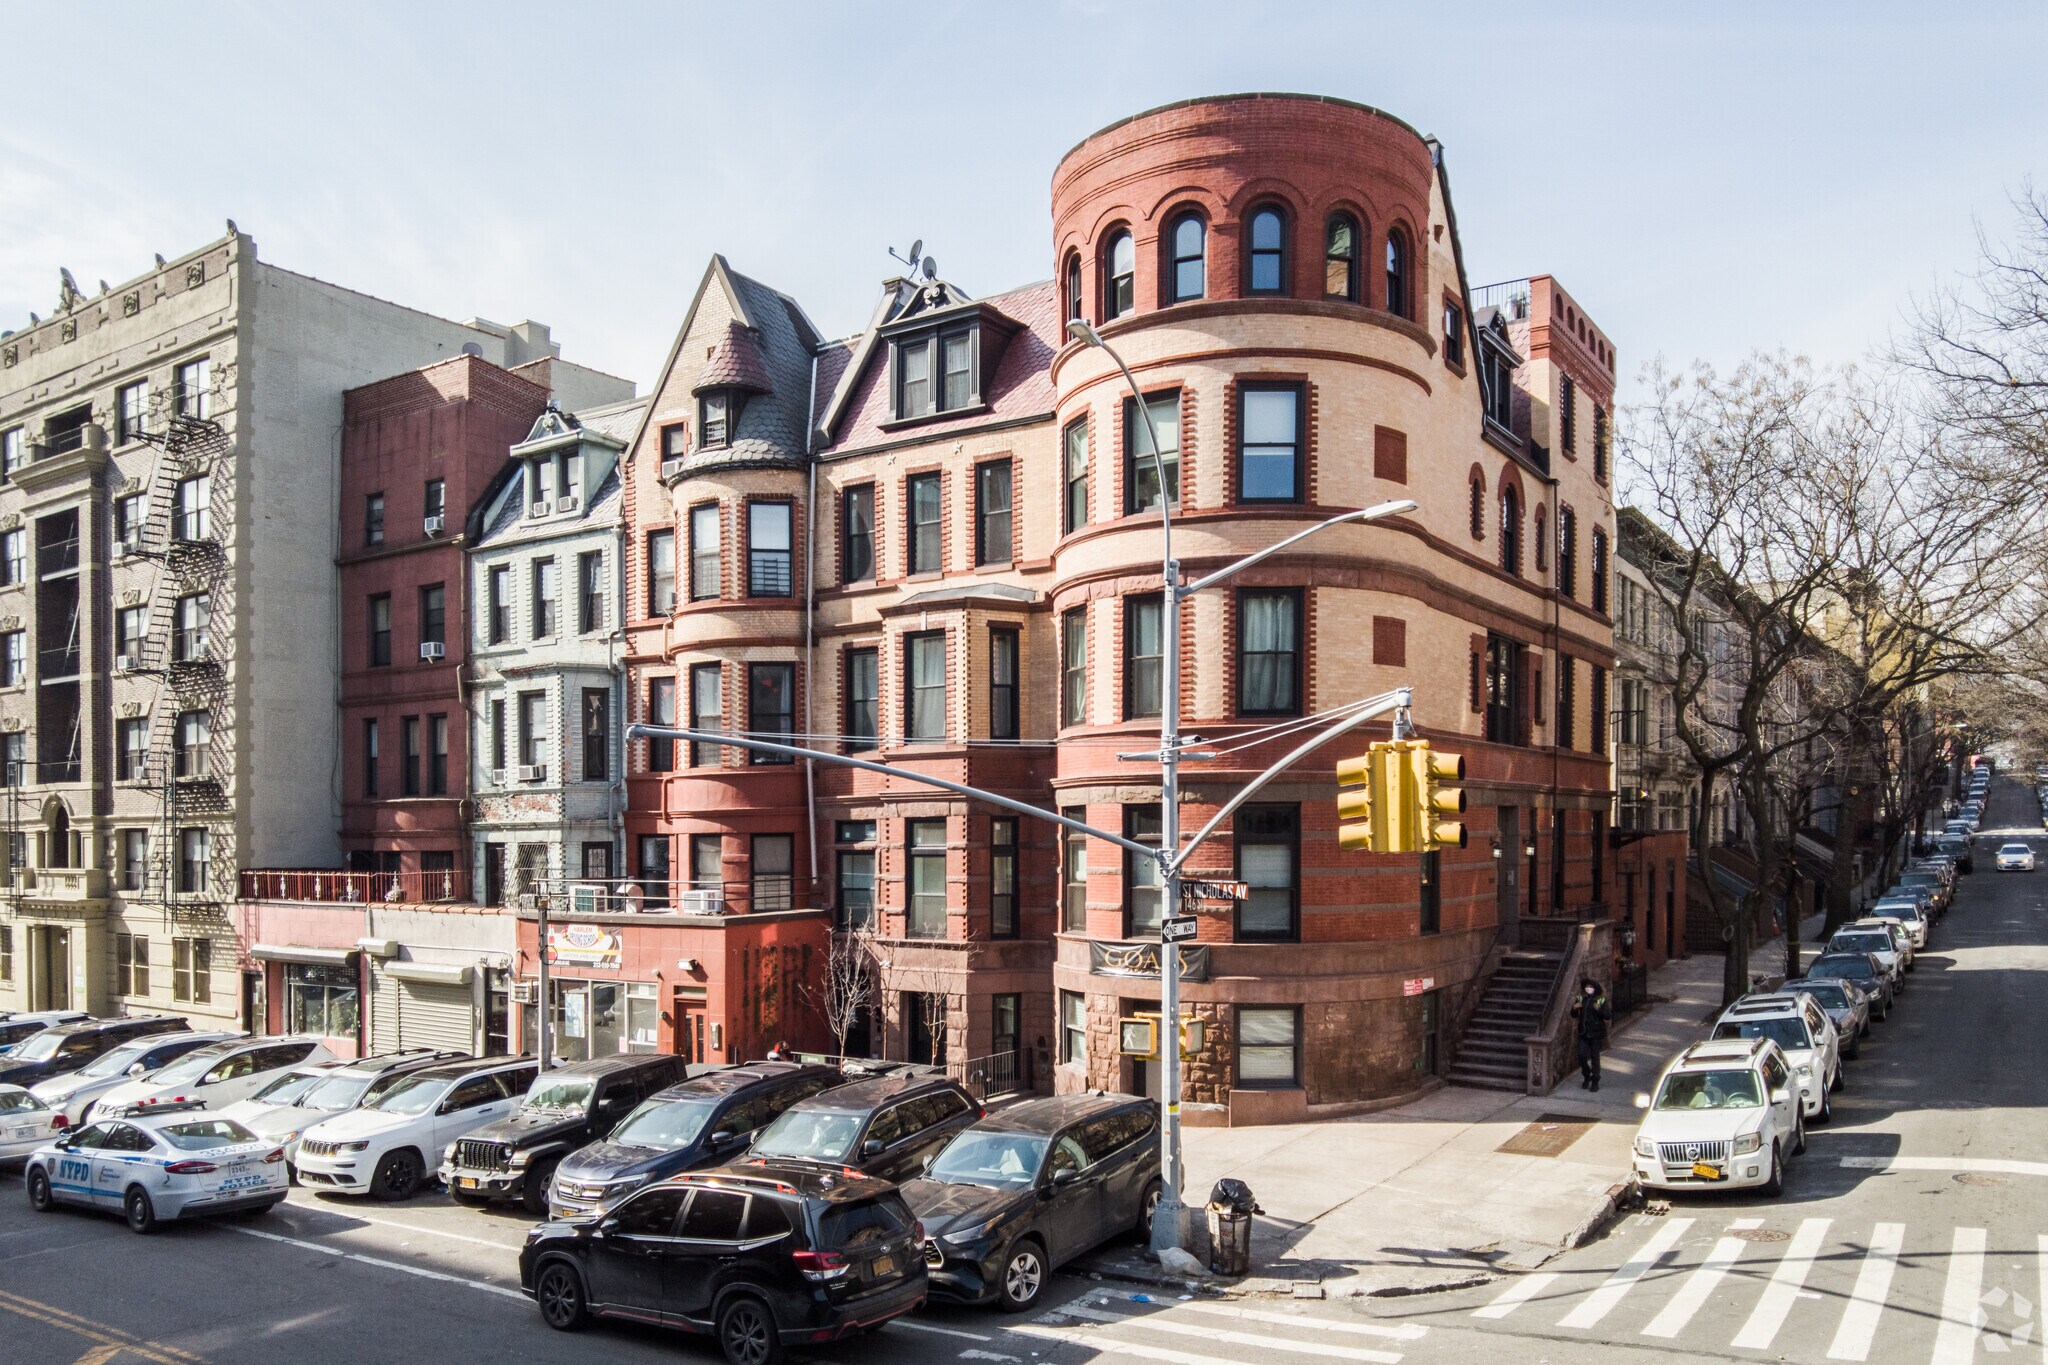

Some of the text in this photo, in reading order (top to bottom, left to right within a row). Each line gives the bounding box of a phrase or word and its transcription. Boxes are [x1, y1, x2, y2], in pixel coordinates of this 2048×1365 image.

[1182, 883, 1247, 899] ST NICHOLAS AV
[1185, 898, 1197, 911] 146
[1165, 923, 1195, 936] ONE WAY
[1105, 949, 1188, 977] GOAS
[59, 1159, 89, 1182] NYPD
[218, 1179, 268, 1191] POLICE
[223, 1174, 261, 1185] NYPD
